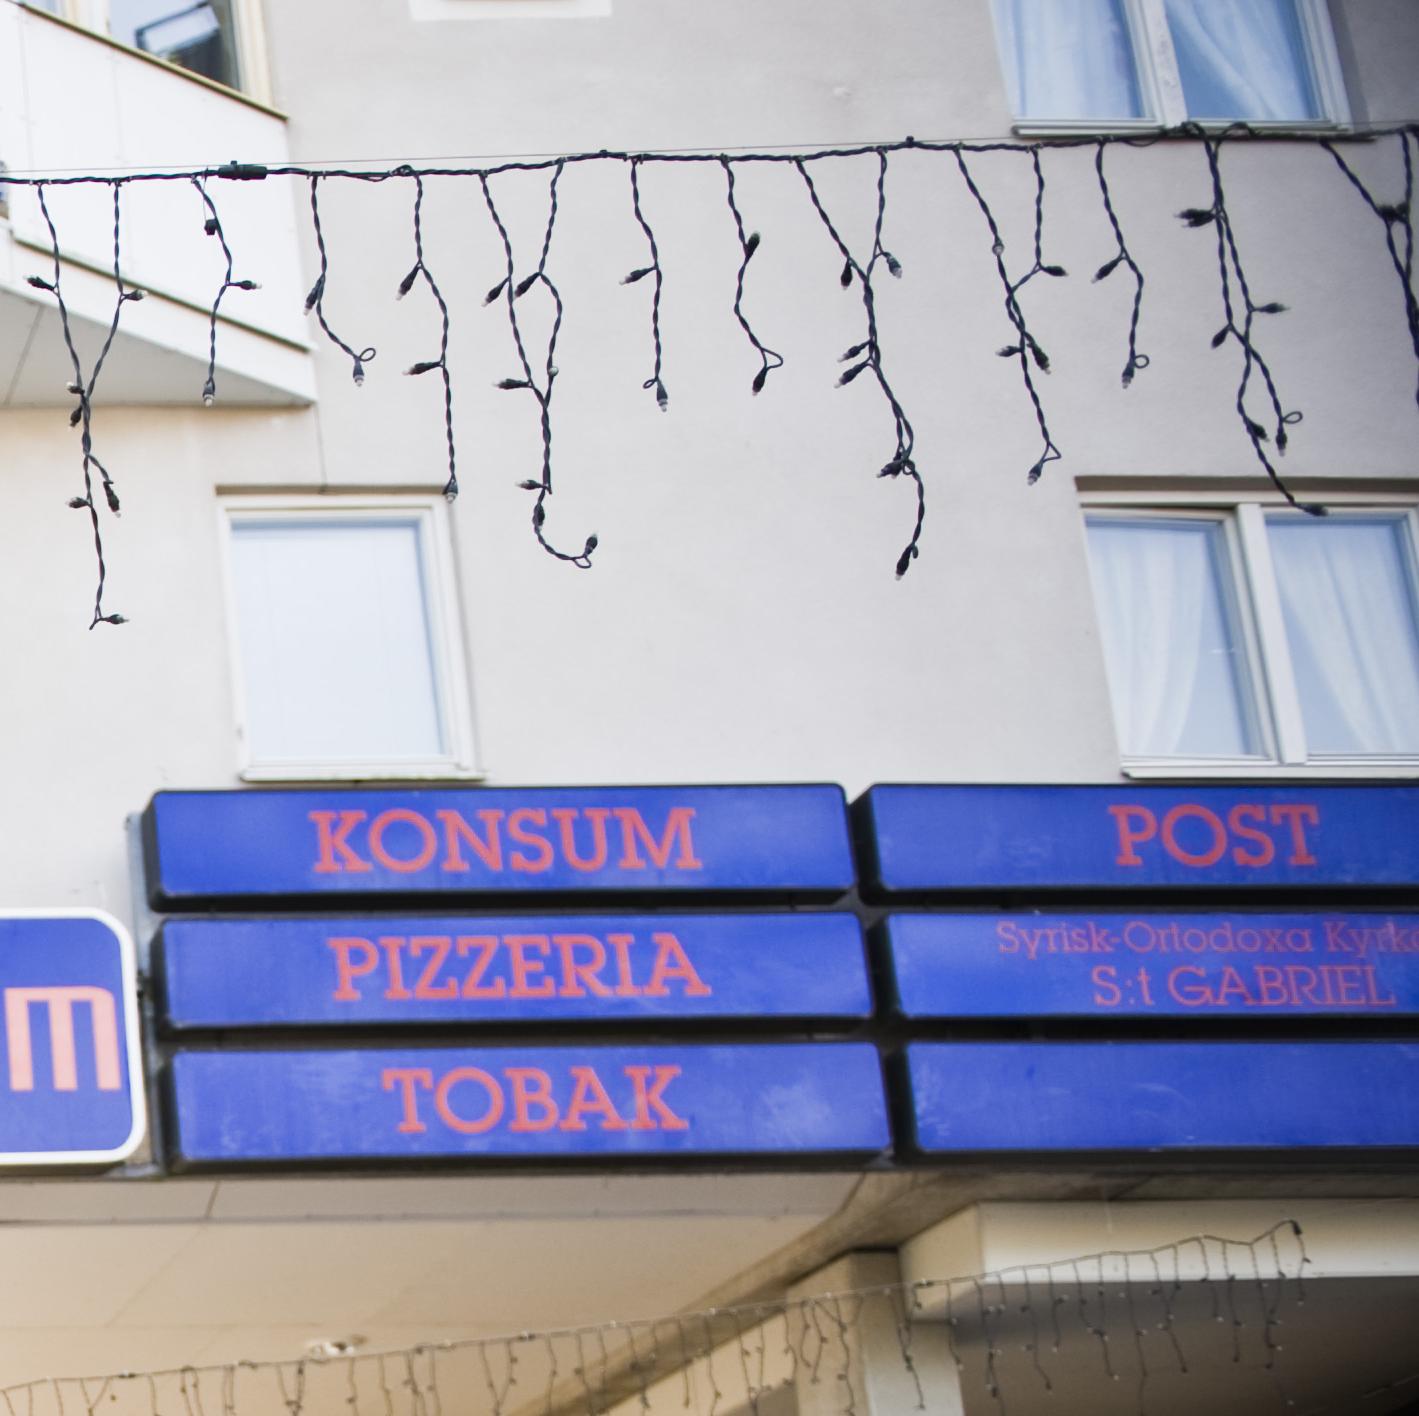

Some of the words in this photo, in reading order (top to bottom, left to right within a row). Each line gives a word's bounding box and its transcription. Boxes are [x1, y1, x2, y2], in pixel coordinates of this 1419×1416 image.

[308, 807, 703, 874] KONSUM
[1108, 803, 1320, 867] POST
[328, 932, 712, 1001] PIZZERIA
[997, 921, 1313, 959] Syrisk-Ortodoxa
[1167, 965, 1396, 1006] GABRIEL
[382, 1065, 689, 1134] TOBAK
